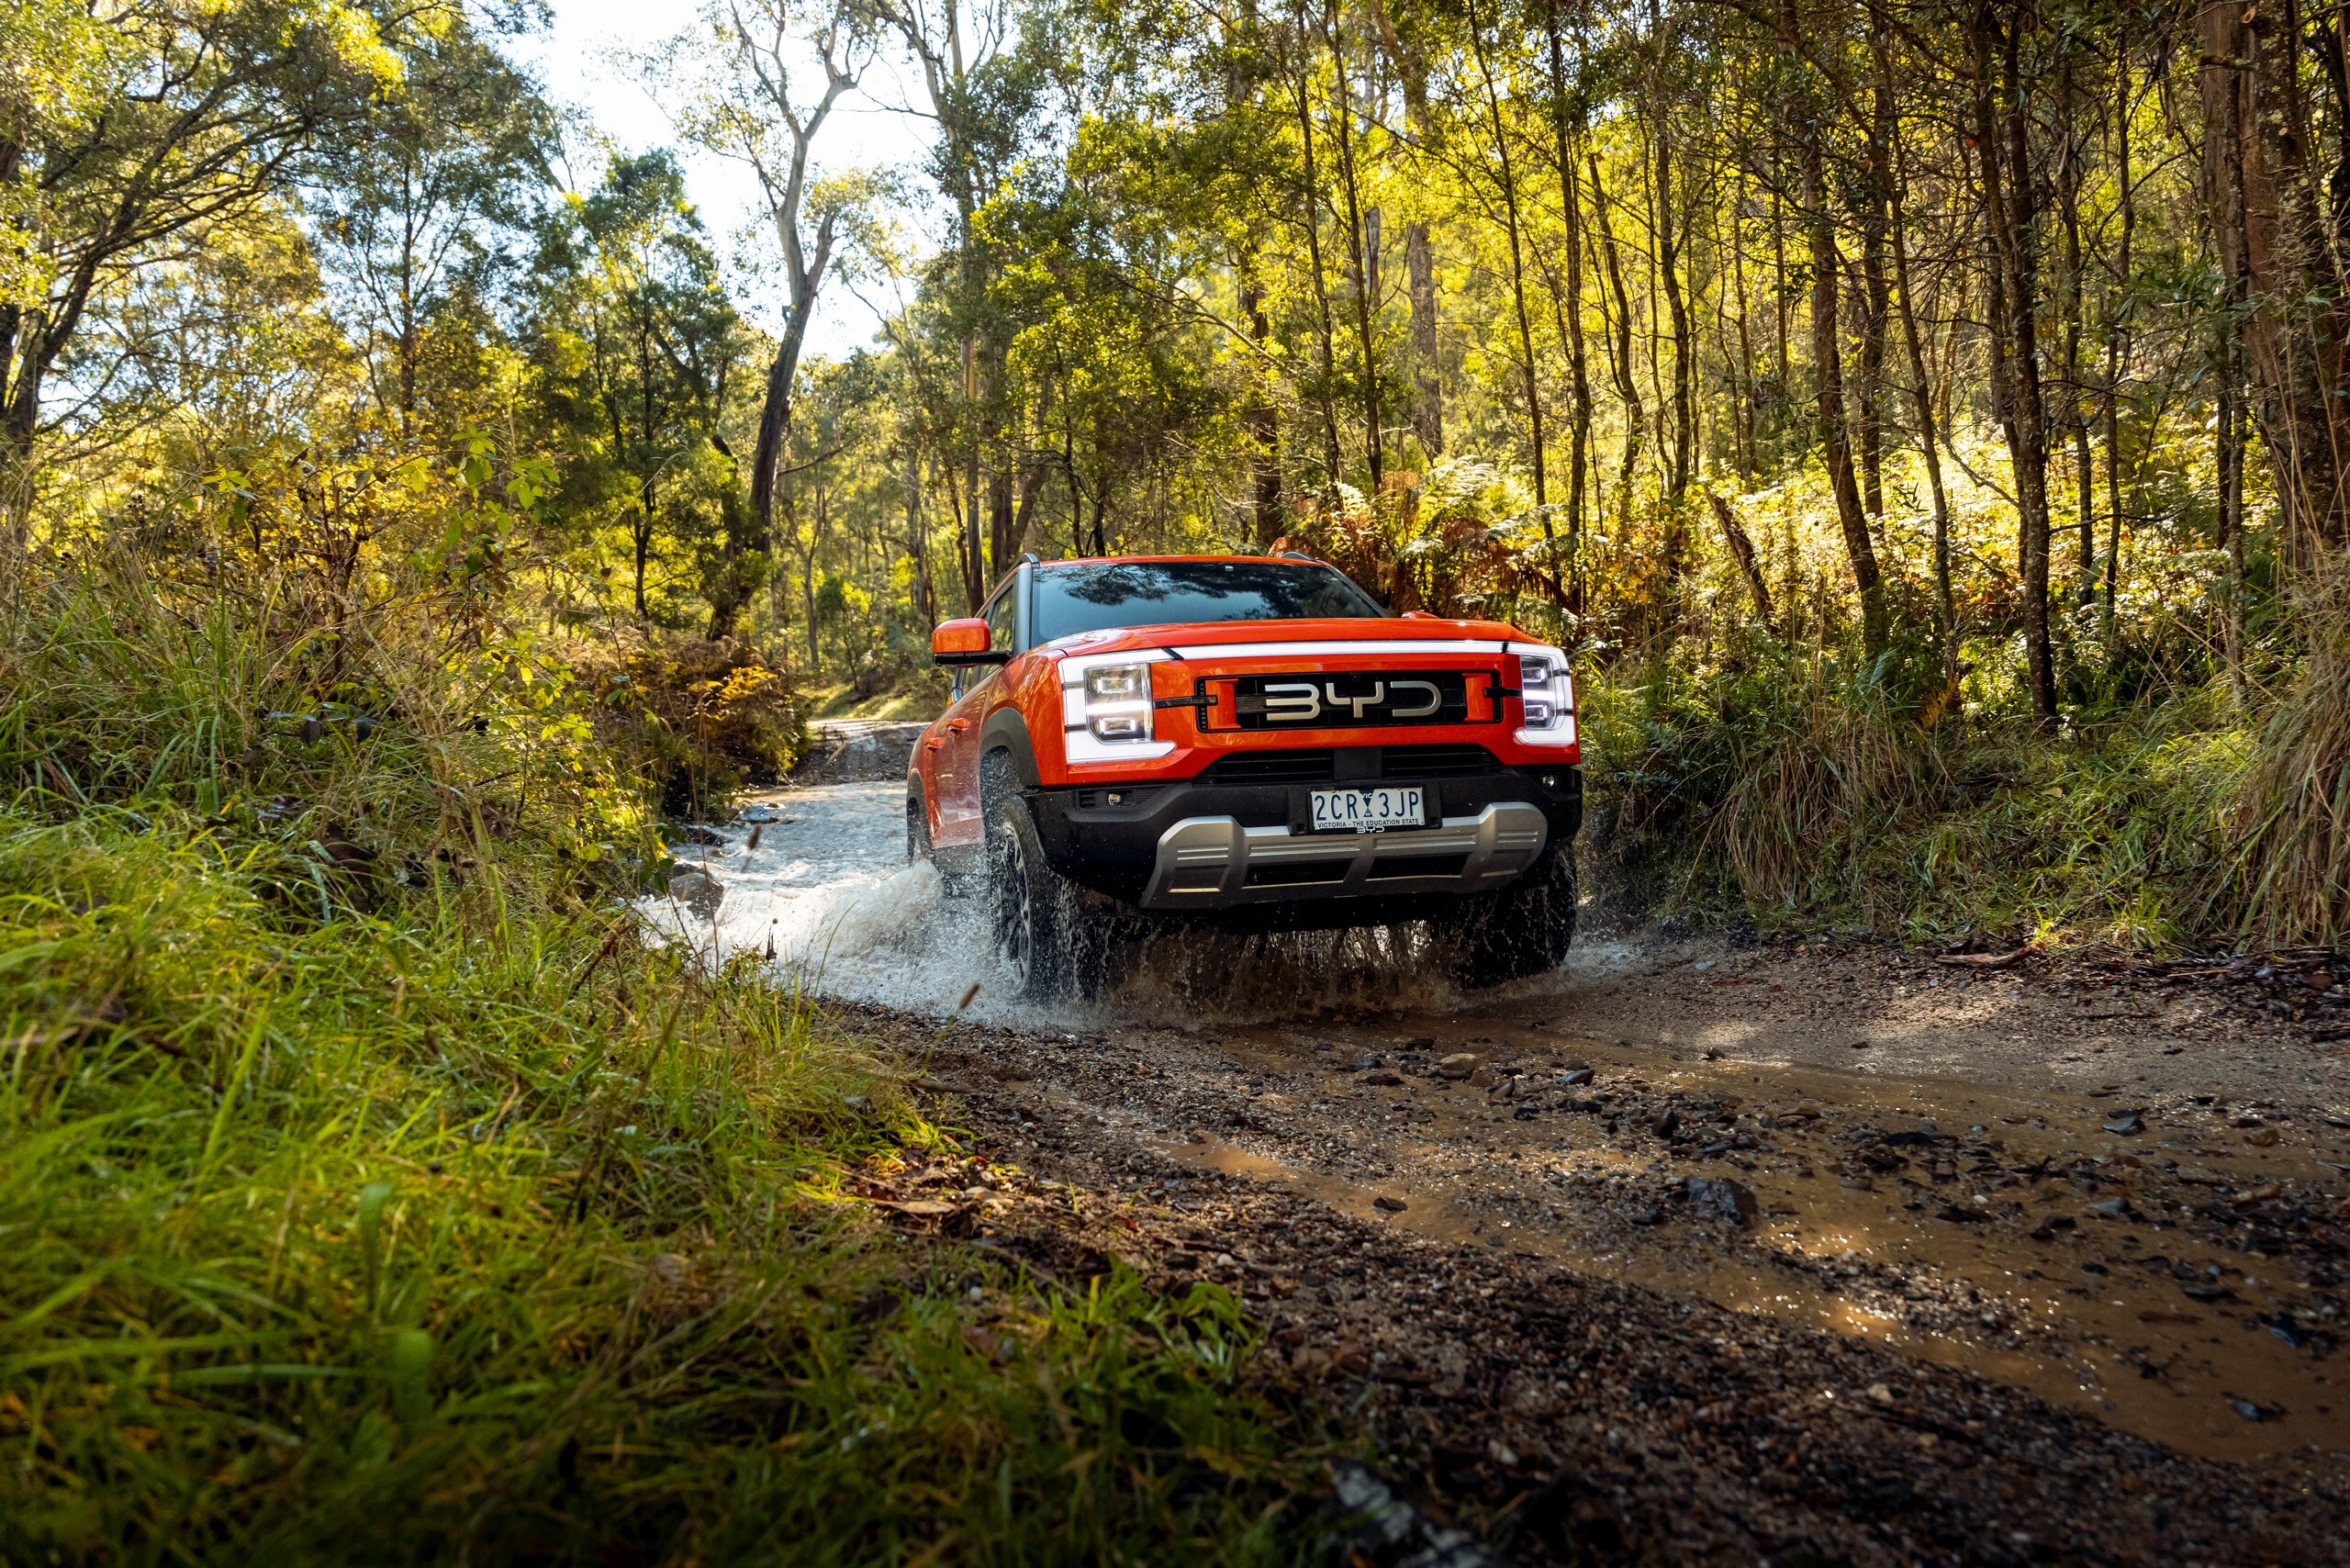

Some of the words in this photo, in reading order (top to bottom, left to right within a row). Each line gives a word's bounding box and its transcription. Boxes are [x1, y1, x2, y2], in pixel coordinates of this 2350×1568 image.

[1265, 681, 1441, 721] BYD
[1315, 794, 1358, 821] 2CR
[1379, 791, 1419, 817] 3JP
